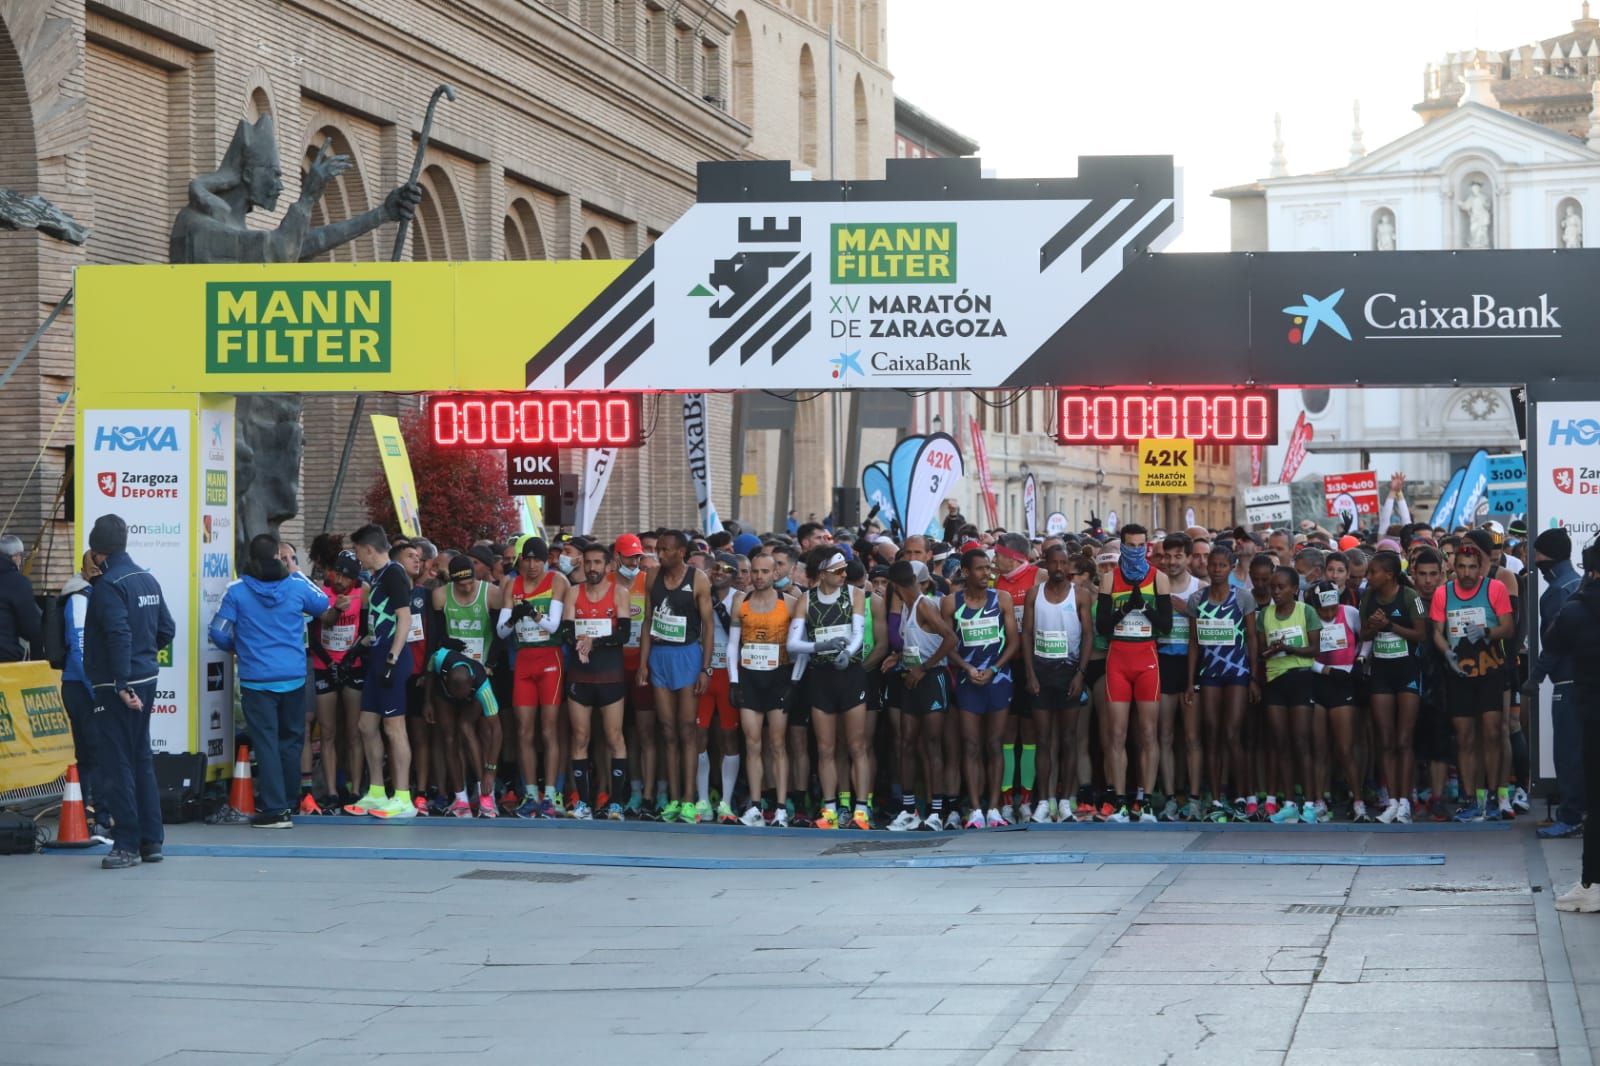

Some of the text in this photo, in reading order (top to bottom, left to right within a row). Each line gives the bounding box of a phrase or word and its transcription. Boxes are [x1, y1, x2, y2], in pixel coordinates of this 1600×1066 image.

[838, 228, 949, 251] MANN
[838, 254, 949, 277] FILTER
[217, 290, 380, 324] MANN
[829, 288, 992, 314] XV MARATÓN
[1363, 292, 1562, 330] CaixaBank
[830, 318, 1008, 338] DE ZARAGOZA
[217, 330, 381, 363] FILTER
[871, 352, 972, 372] CaixaBank
[94, 426, 178, 451] HOKA
[1548, 418, 1600, 446] HO
[512, 456, 553, 473] 10K
[927, 450, 954, 471] 42K
[1144, 449, 1188, 467] 42K
[121, 471, 178, 486] Zaragoza
[512, 478, 554, 486] ZARAGOZA
[1145, 480, 1188, 488] ZARAGOZA
[1147, 471, 1186, 480] MARATÓN
[203, 553, 229, 578] HOKA
[450, 619, 481, 630] LEA
